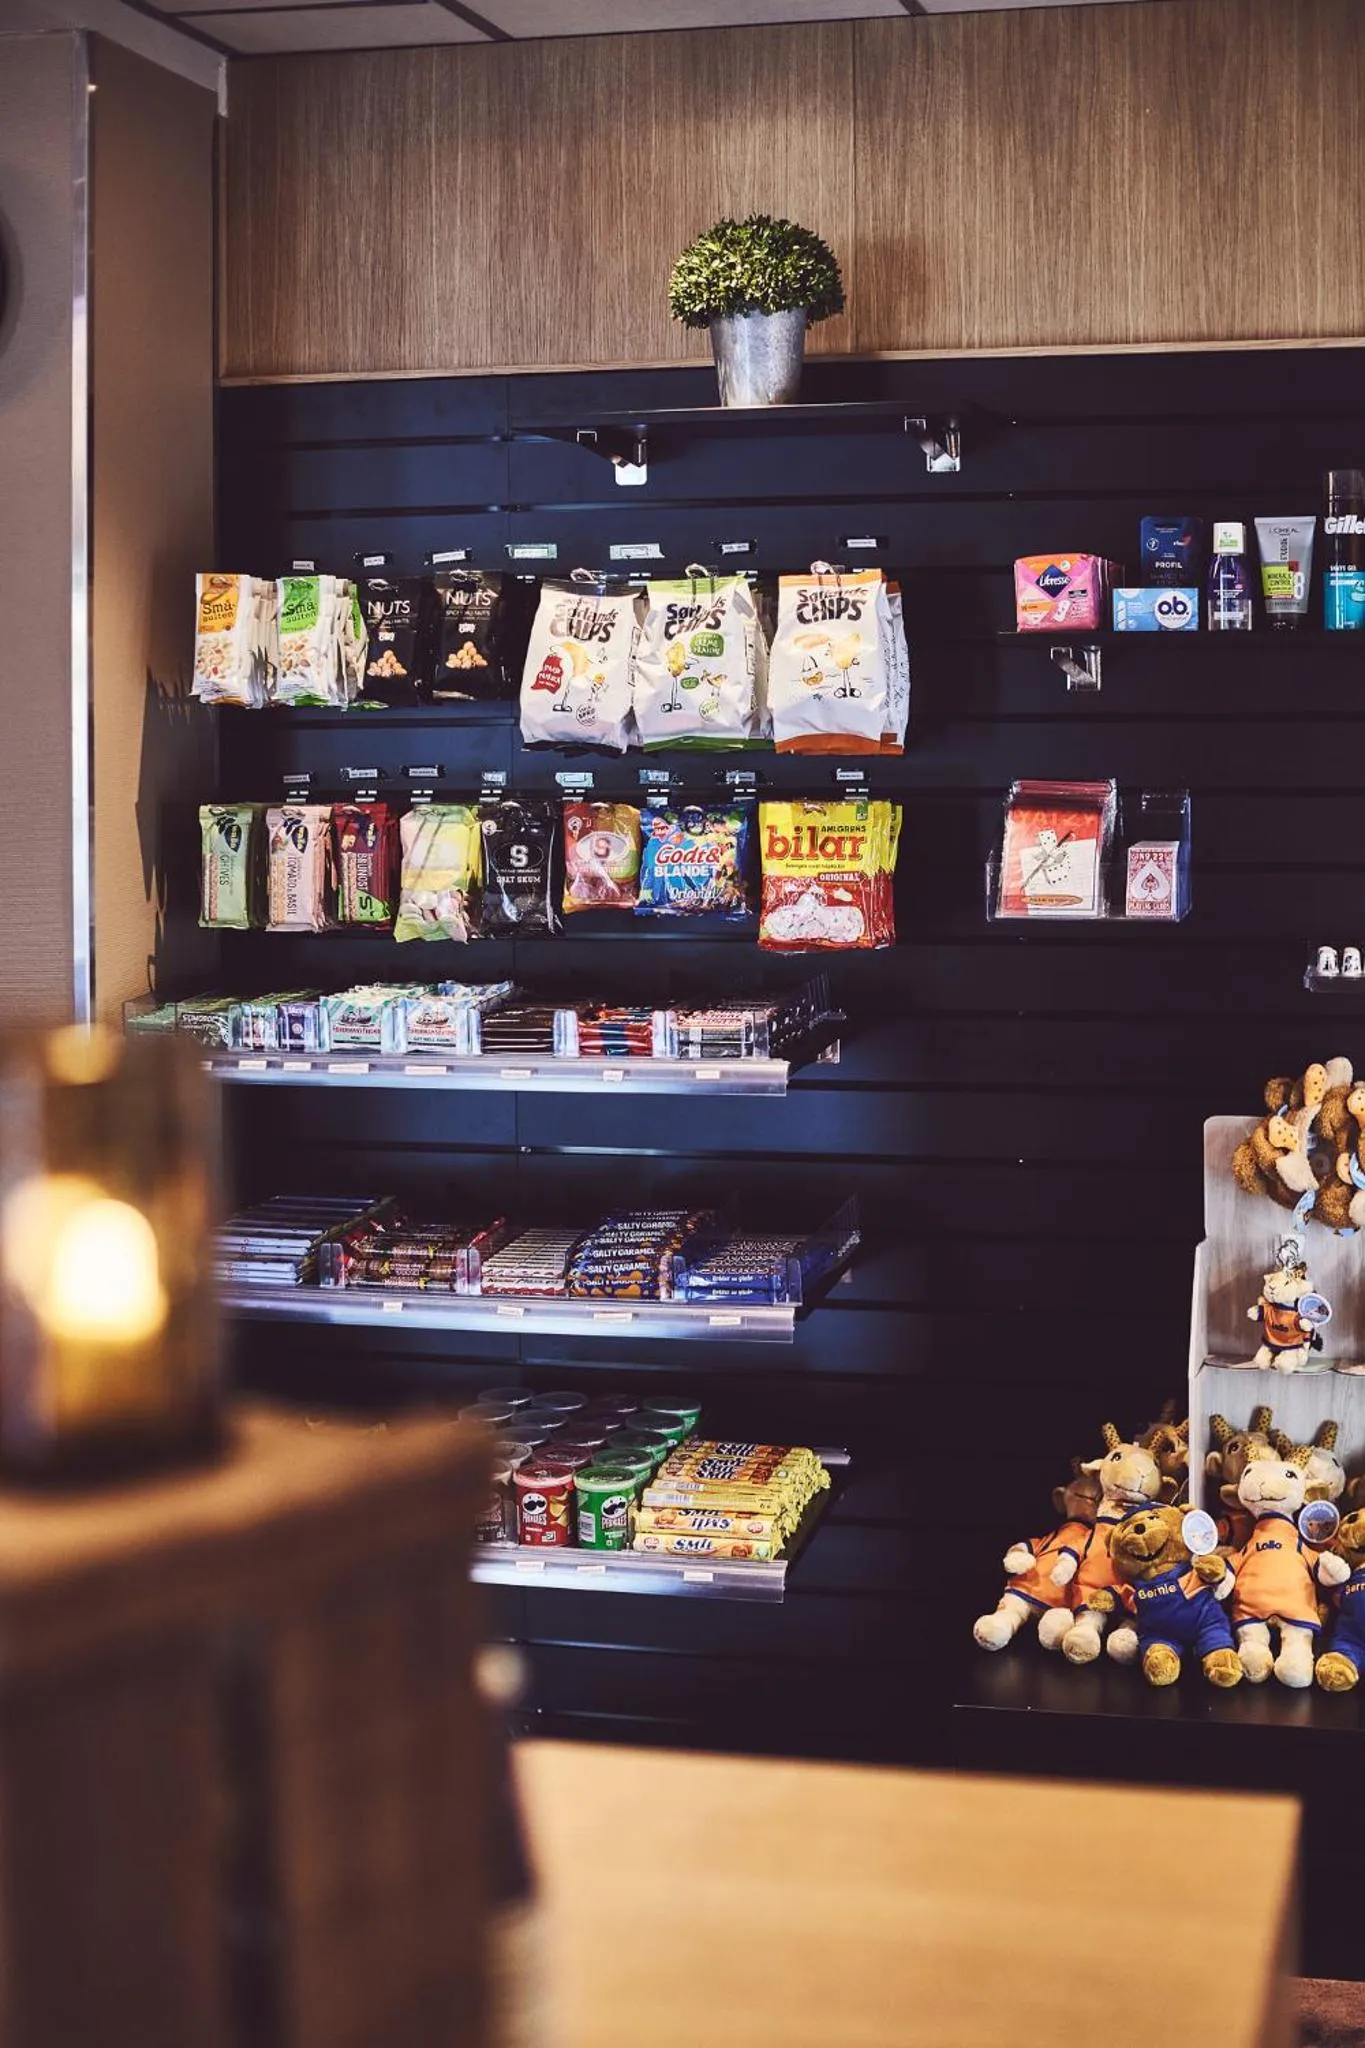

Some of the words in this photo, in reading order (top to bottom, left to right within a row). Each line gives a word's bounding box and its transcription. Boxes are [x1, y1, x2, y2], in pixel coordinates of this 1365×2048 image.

[446, 589, 492, 606] NUTS
[367, 600, 412, 616] NUTS
[796, 597, 867, 625] CHIPS
[1157, 596, 1190, 616] o.b.
[821, 825, 867, 833] AHLGRENS
[765, 825, 868, 860] bilar
[509, 844, 529, 868] S
[654, 865, 717, 877] BLANDET
[819, 873, 861, 881] ORIGINAL
[617, 1221, 641, 1230] SALTY
[641, 1221, 677, 1229] CARAMEL
[592, 1249, 617, 1258] SALTY
[617, 1248, 656, 1256] CARAMEL
[587, 1264, 612, 1274] SALTY
[612, 1261, 651, 1271] CARAMEL
[1137, 1584, 1177, 1600] Bernie
